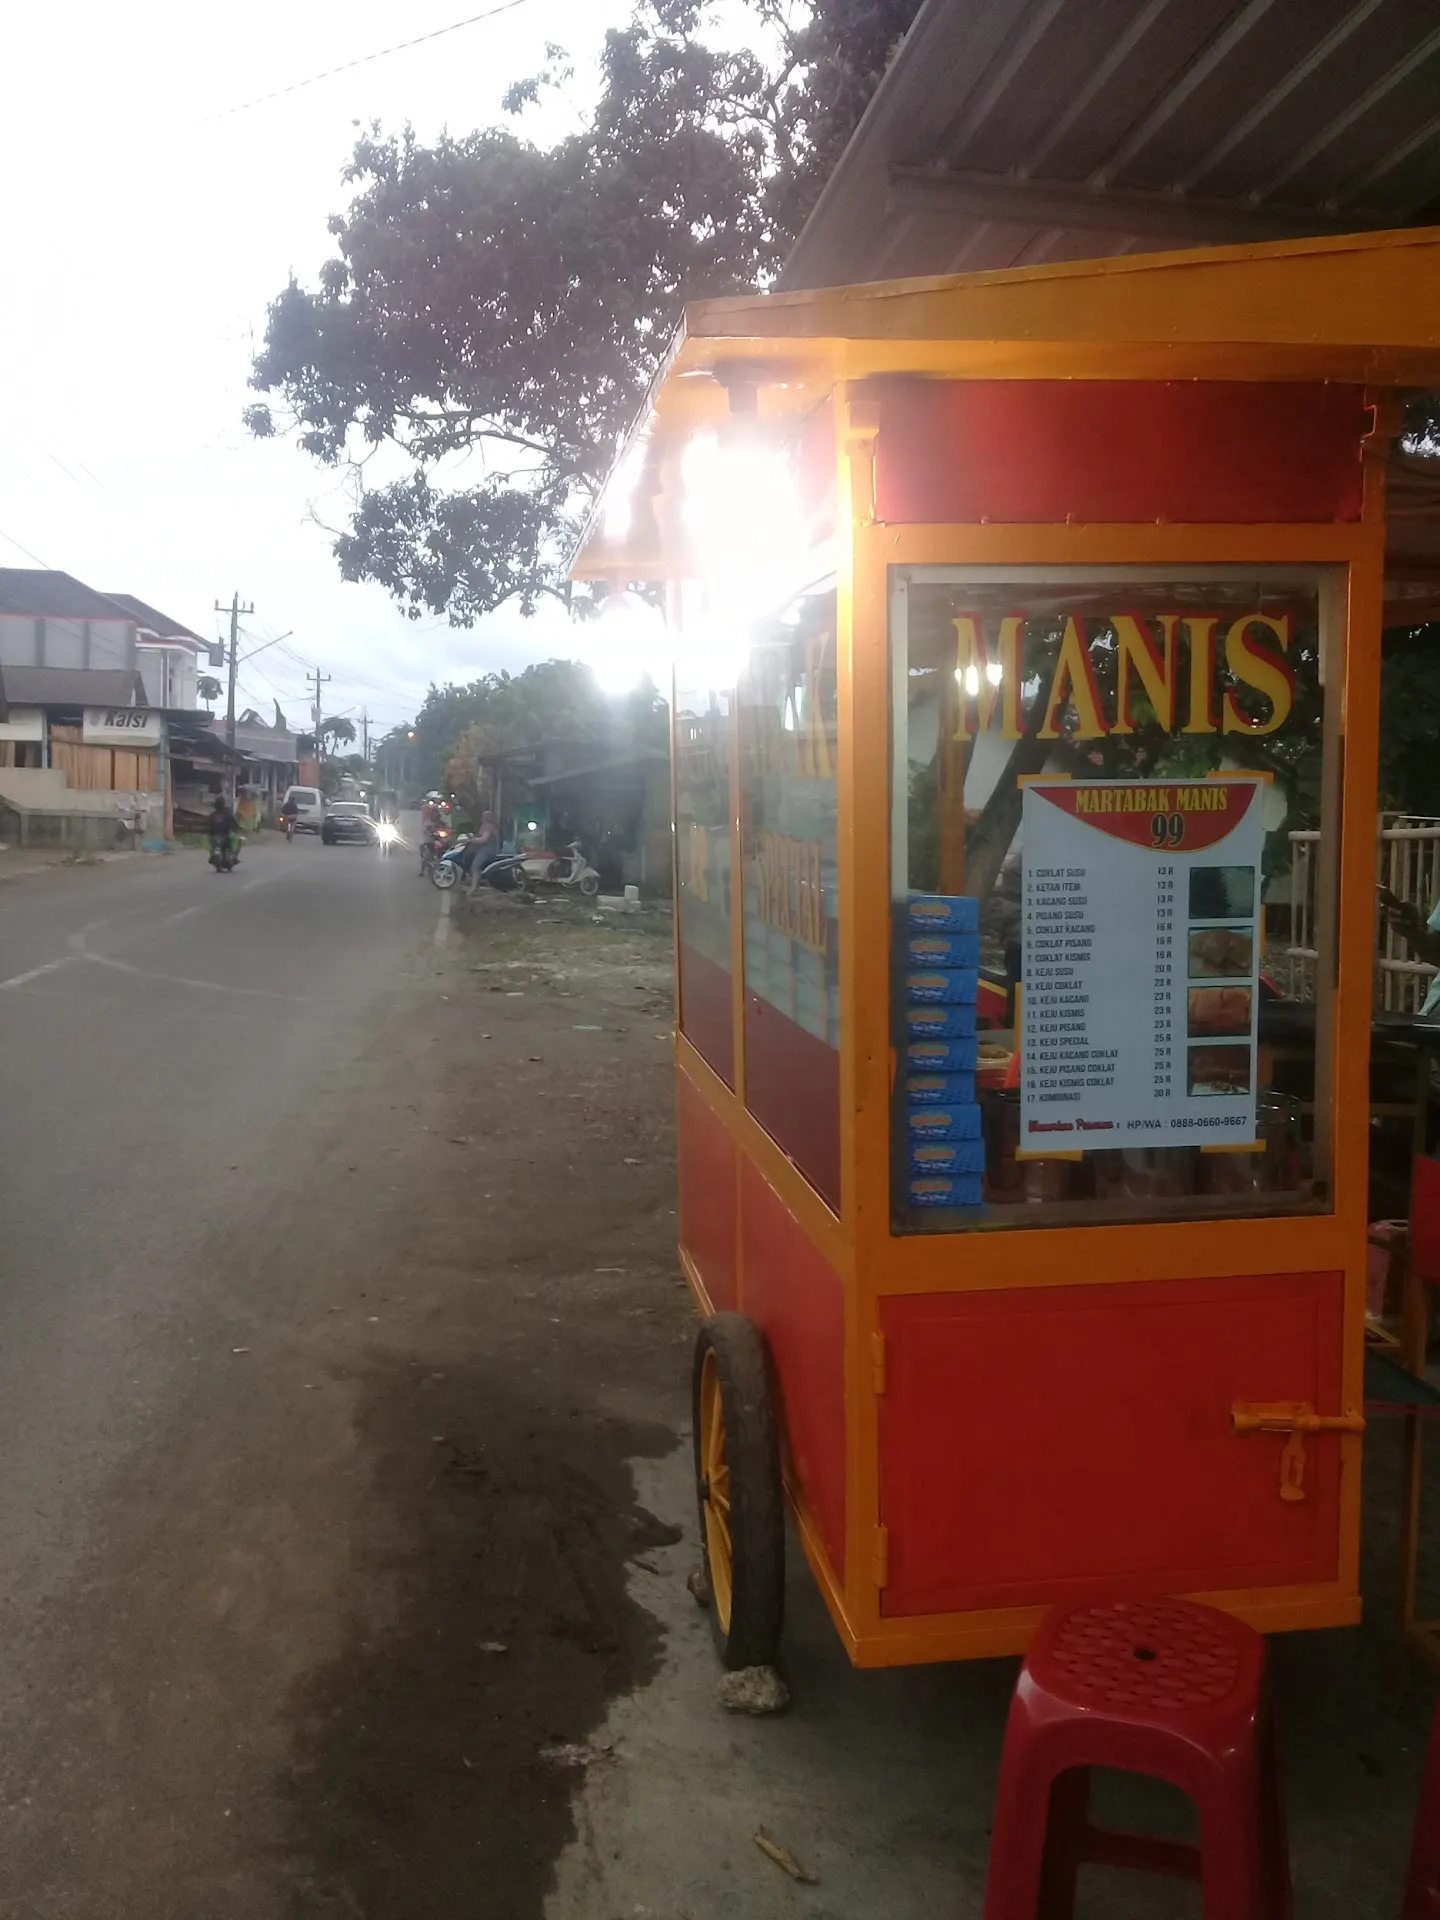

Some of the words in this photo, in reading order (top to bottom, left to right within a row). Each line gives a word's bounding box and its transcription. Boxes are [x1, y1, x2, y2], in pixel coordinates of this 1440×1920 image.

[953, 612, 1295, 741] MANIS
[1076, 788, 1170, 813] MARTABAK
[1176, 786, 1228, 811] MANIS
[1151, 812, 1185, 847] 99
[1036, 869, 1065, 877] COKLAT
[1066, 868, 1086, 877] SUSU
[1158, 867, 1168, 875] 13
[1036, 883, 1060, 891] KETAN
[1062, 882, 1081, 891] ITEM
[1158, 881, 1168, 889] 13
[1036, 898, 1067, 906] KACANG
[1068, 897, 1088, 905] SUSU
[1157, 895, 1167, 903] 13
[1036, 912, 1063, 920] PISANG
[1064, 911, 1084, 919] SUSU
[1157, 909, 1167, 917] 13
[1036, 926, 1064, 934] COKLAT
[1065, 924, 1095, 933] KACANG
[1156, 923, 1166, 931] 16
[1035, 940, 1063, 948] COKLAT
[1065, 939, 1092, 947] PISANG
[1156, 937, 1166, 945] 16
[1035, 954, 1063, 962] COKLAT
[1065, 953, 1091, 961] KISMIS
[1156, 951, 1166, 959] 16
[1035, 968, 1053, 976] KEJU
[1055, 967, 1074, 976] SUSU
[1155, 965, 1166, 973] 20
[1035, 982, 1053, 990] KEJU
[1054, 981, 1083, 989] COKLAT
[1154, 979, 1165, 987] 23
[1040, 996, 1057, 1005] KEJU
[1059, 995, 1089, 1003] KACANG
[1154, 993, 1165, 1001] 23
[1040, 1010, 1057, 1018] KEJU
[1059, 1009, 1085, 1017] KISMIS
[1040, 1024, 1057, 1032] KEJU
[1060, 1023, 1086, 1031] PISANG
[1154, 1020, 1165, 1028] 23
[1040, 1038, 1057, 1046] KEJU
[1059, 1037, 1089, 1045] SPECIAL
[1154, 1034, 1165, 1042] 25
[1039, 1052, 1057, 1060] KEJU
[1059, 1051, 1089, 1059] KACANG
[1091, 1049, 1118, 1058] COKLAT
[1154, 1048, 1165, 1056] 25
[1040, 1066, 1057, 1074] KEJU
[1059, 1065, 1086, 1073] PISANG
[1088, 1063, 1115, 1072] COKLAT
[1154, 1062, 1165, 1070] 25
[1039, 1080, 1057, 1088] KEJU
[1059, 1079, 1084, 1087] KISMIS
[1086, 1077, 1114, 1086] COKLAT
[1154, 1076, 1165, 1084] 25
[1153, 1089, 1165, 1097] 30
[1127, 1119, 1162, 1130] HP/WA
[1171, 1116, 1247, 1129] 0888-0660-9667
